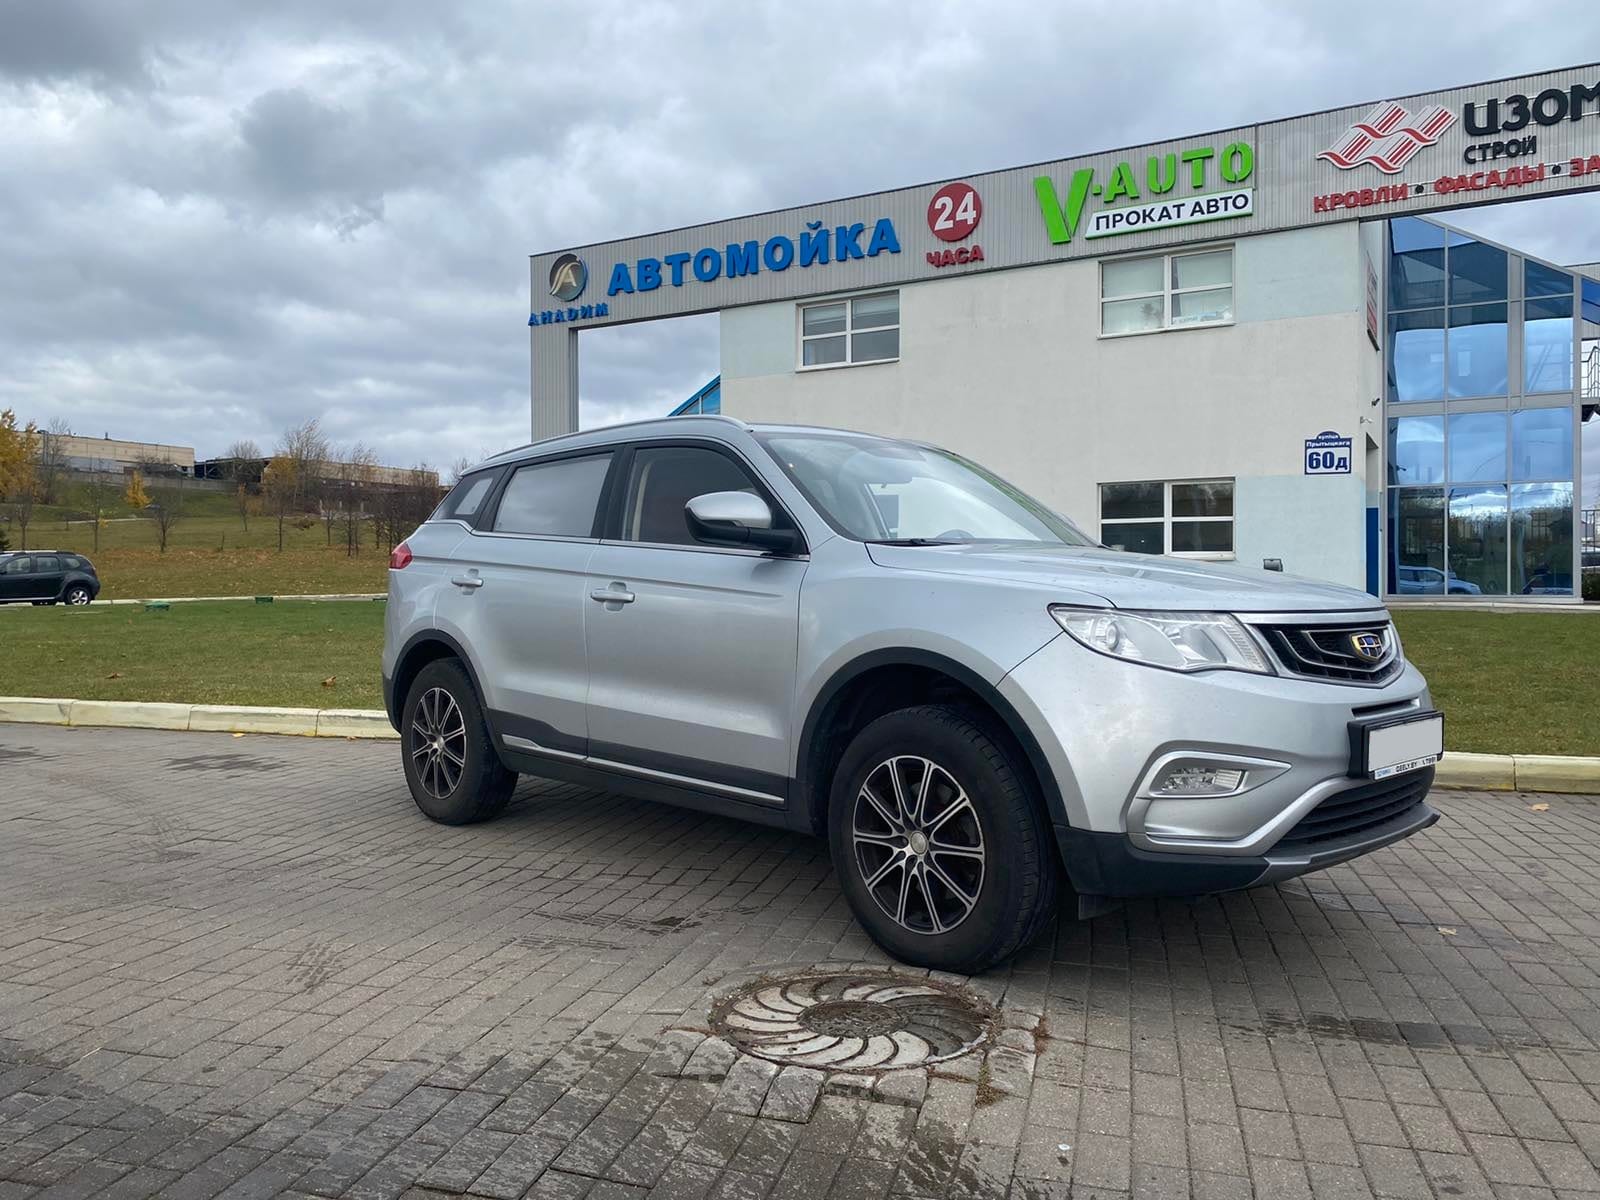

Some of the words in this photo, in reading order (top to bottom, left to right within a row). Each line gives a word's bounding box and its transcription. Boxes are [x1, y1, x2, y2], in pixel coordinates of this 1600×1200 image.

[1464, 135, 1537, 164] СТРОЙ
[1313, 183, 1408, 213] КРОВЛИ
[1433, 162, 1545, 195] ФАСАДЫ
[933, 190, 977, 231] 24
[1095, 203, 1186, 231] ПРОКАТ
[1190, 193, 1249, 217] АВТО
[607, 218, 901, 296] АВТОМОЙКА
[926, 244, 985, 268] ЧАСА
